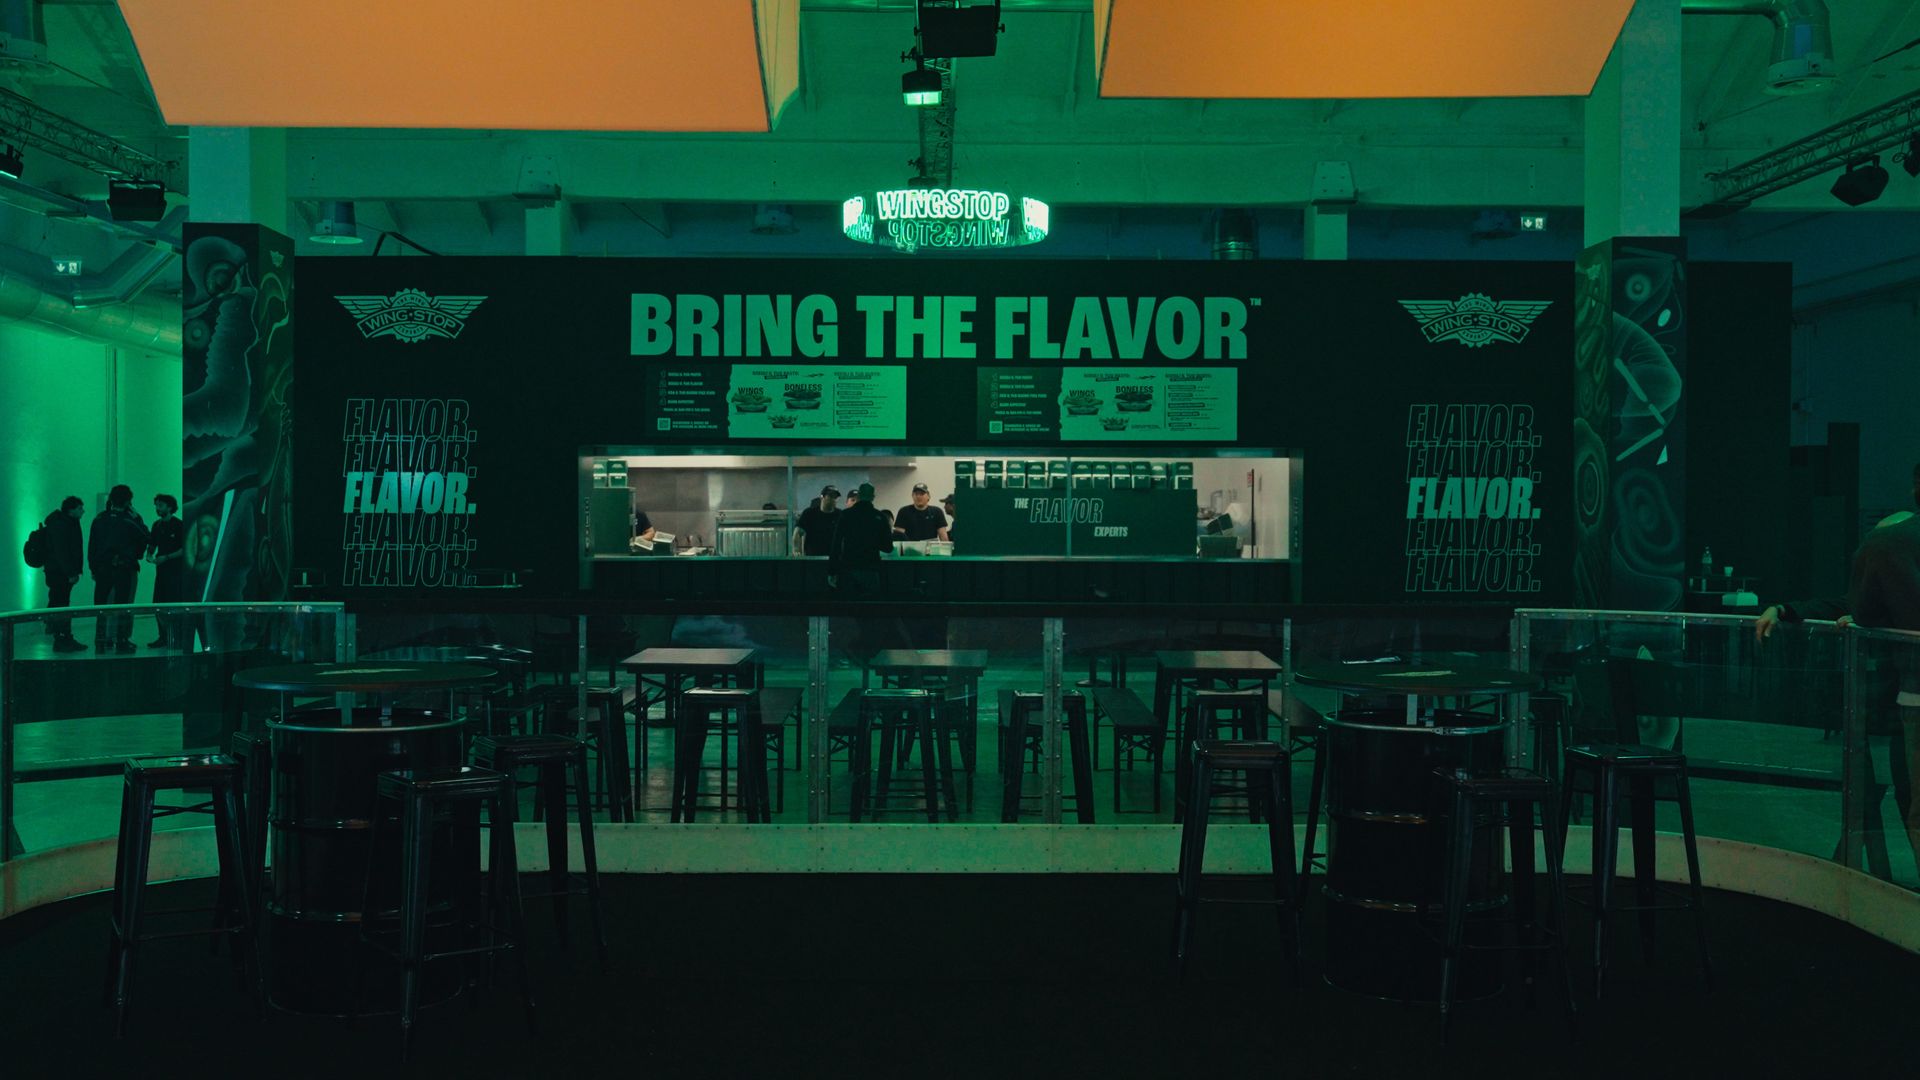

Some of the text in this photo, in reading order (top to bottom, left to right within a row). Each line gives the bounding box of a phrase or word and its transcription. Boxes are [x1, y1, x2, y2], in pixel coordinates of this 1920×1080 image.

[876, 189, 1010, 221] WINGSTOP
[630, 293, 838, 356] BRING
[856, 294, 976, 358] THE
[738, 386, 764, 395] WINGS
[784, 383, 823, 392] BONELESS
[343, 399, 477, 441] FLAVOR.
[1406, 404, 1542, 447] FLAVOR.
[343, 435, 477, 478] FLAVOR.
[1406, 441, 1542, 483] FLAVOR.
[343, 471, 477, 514] FLAVOR.
[1014, 497, 1029, 509] THE
[1031, 498, 1104, 523] FLAVOR
[1406, 477, 1542, 519] FLAVOR.
[343, 508, 477, 550] FLAVOR.
[1094, 526, 1128, 537] EXPERTS
[1406, 513, 1542, 555] FLAVOR.
[1406, 549, 1542, 592] FLAVOR.
